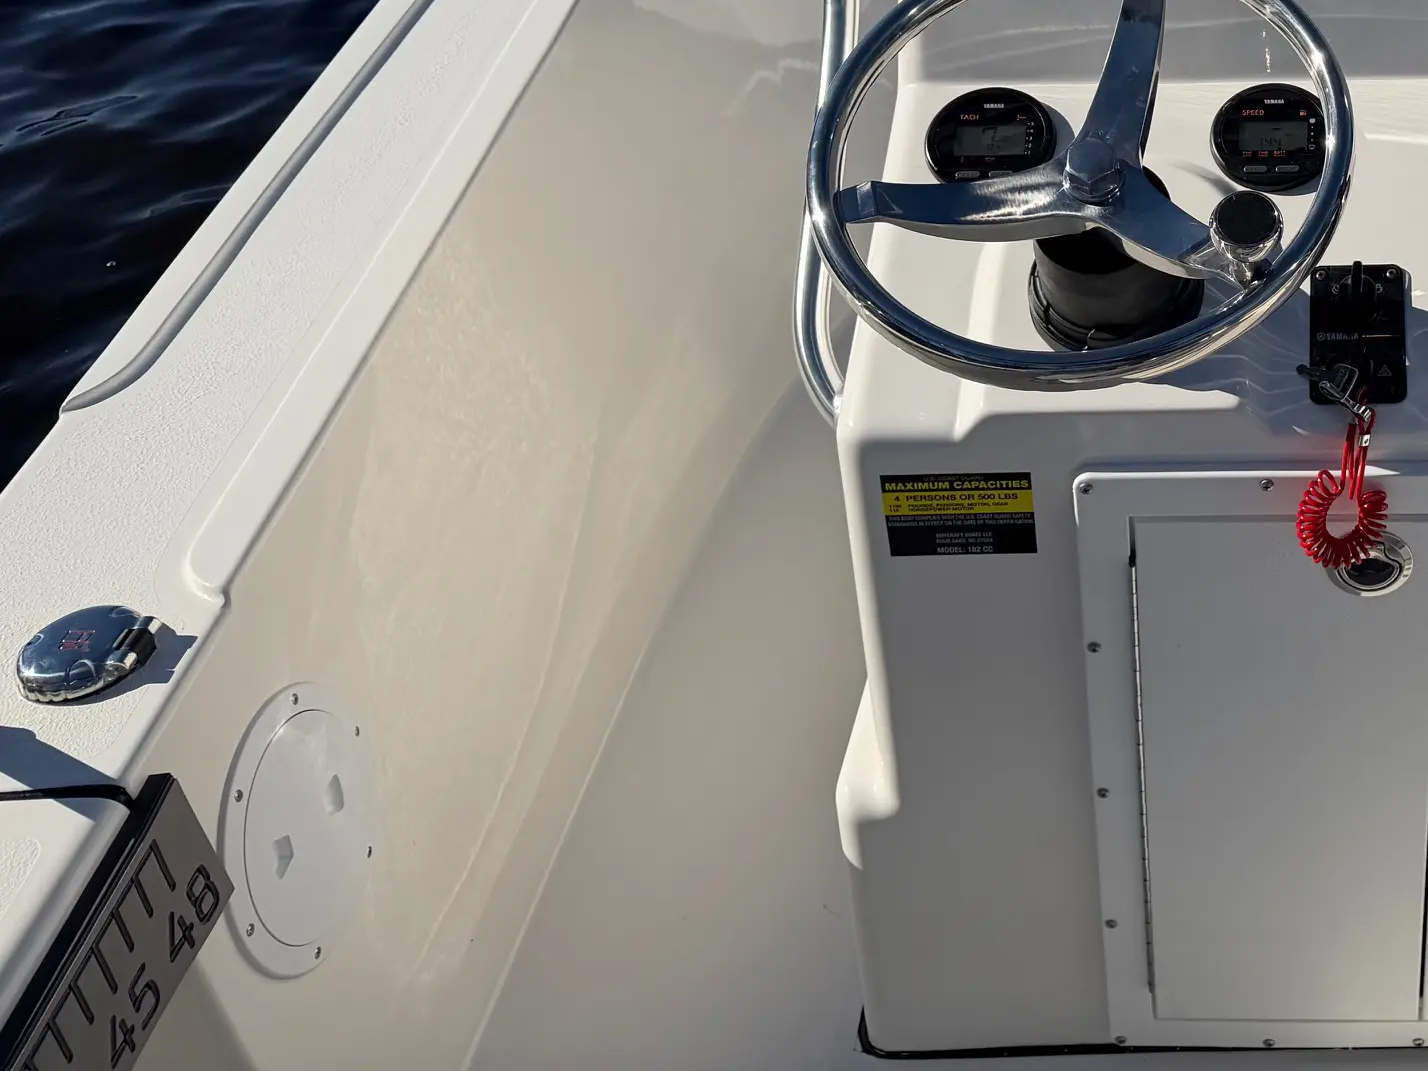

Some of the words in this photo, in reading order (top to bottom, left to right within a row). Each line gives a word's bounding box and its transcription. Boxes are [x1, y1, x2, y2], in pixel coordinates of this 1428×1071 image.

[1326, 332, 1359, 340] YAMAHA
[884, 481, 950, 490] MAXIMUM
[953, 480, 1029, 489] CAPACITIES
[906, 494, 957, 502] PERSONS
[959, 493, 975, 501] OR
[997, 492, 1018, 500] LBS
[937, 546, 967, 554] MODEL:
[982, 545, 994, 553] CC
[168, 863, 220, 963] 48
[110, 962, 161, 1070] 45
